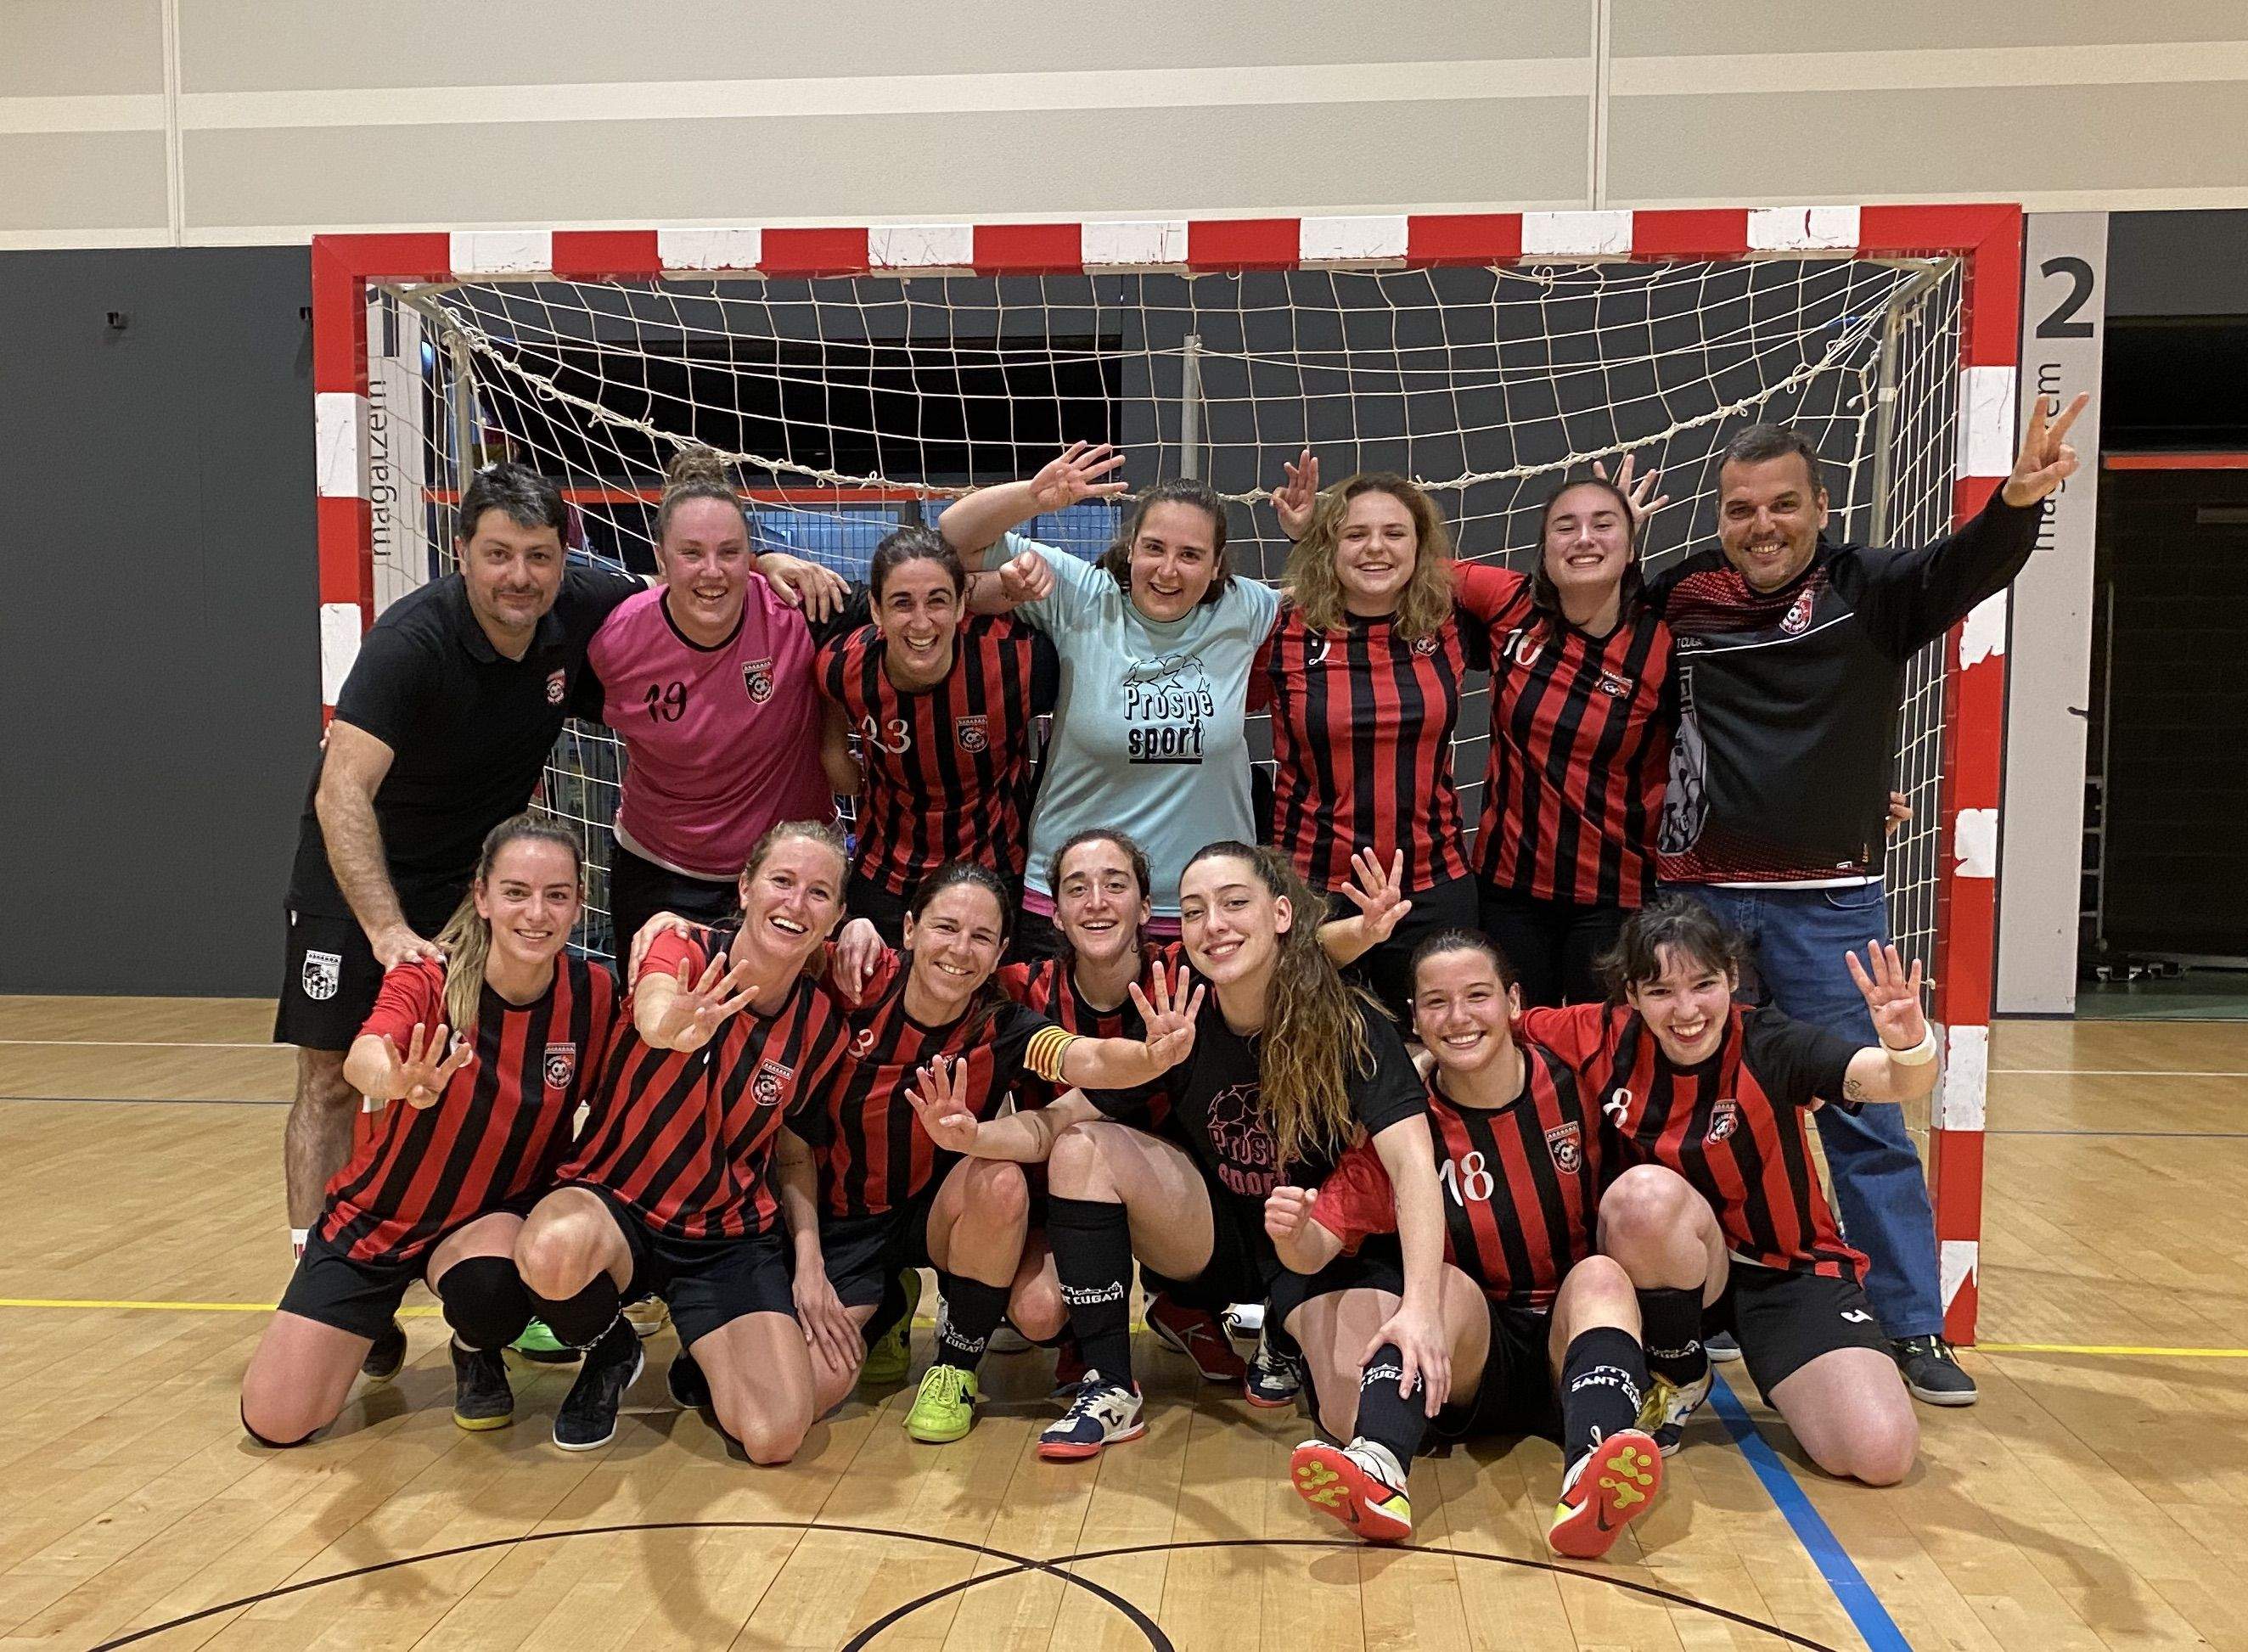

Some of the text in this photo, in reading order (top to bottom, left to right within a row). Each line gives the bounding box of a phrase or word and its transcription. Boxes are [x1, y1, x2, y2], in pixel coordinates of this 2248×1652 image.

[2037, 256, 2094, 338] 2
[643, 681, 688, 723] 19
[1123, 685, 1215, 724] Prospe
[862, 715, 912, 754] 23
[1128, 720, 1206, 758] sport
[1439, 1151, 1494, 1206] 18
[1073, 1292, 1120, 1305] CUGAT
[1571, 1376, 1619, 1392] SANT
